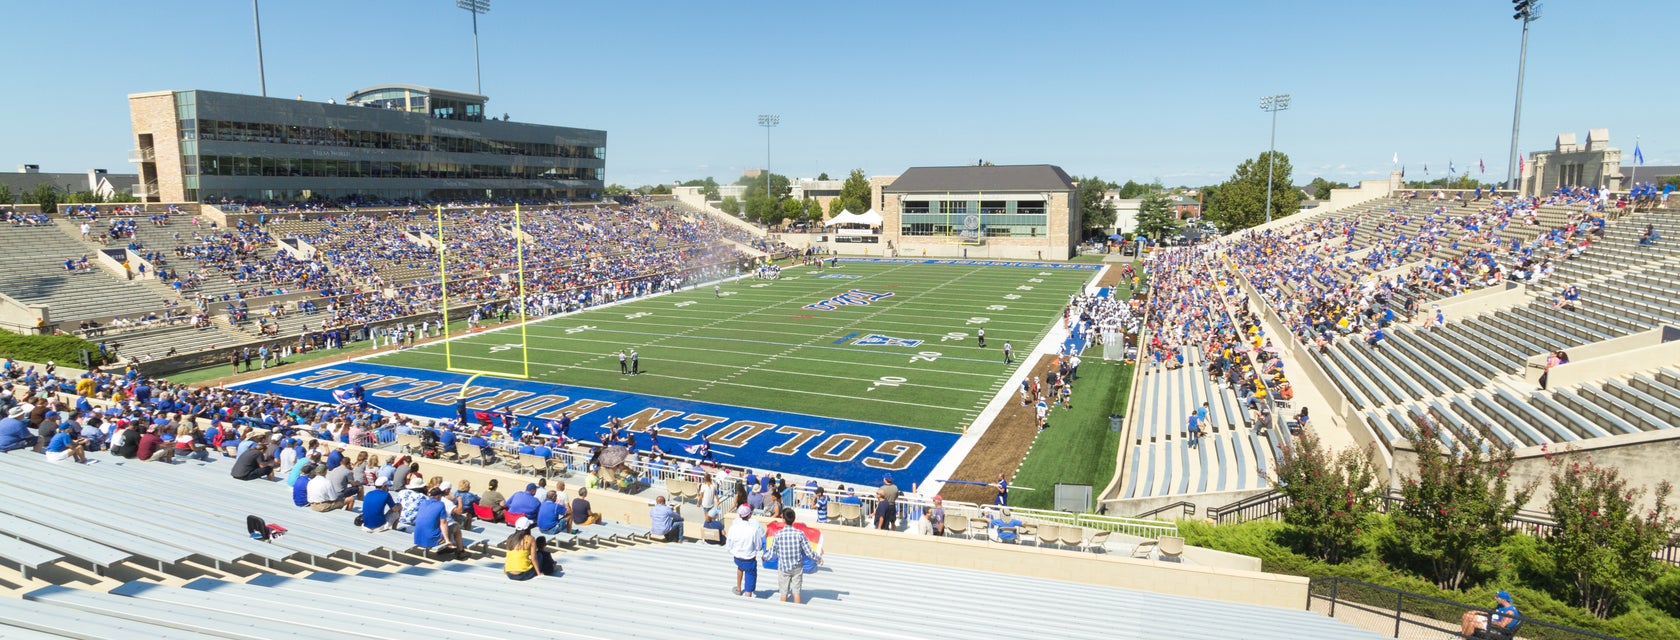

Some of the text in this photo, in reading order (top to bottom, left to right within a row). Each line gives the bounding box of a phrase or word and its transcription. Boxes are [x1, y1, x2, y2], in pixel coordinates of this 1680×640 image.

[912, 351, 943, 362] 20
[873, 376, 907, 387] 10
[273, 368, 927, 471] GOLDEN HURRICANE
